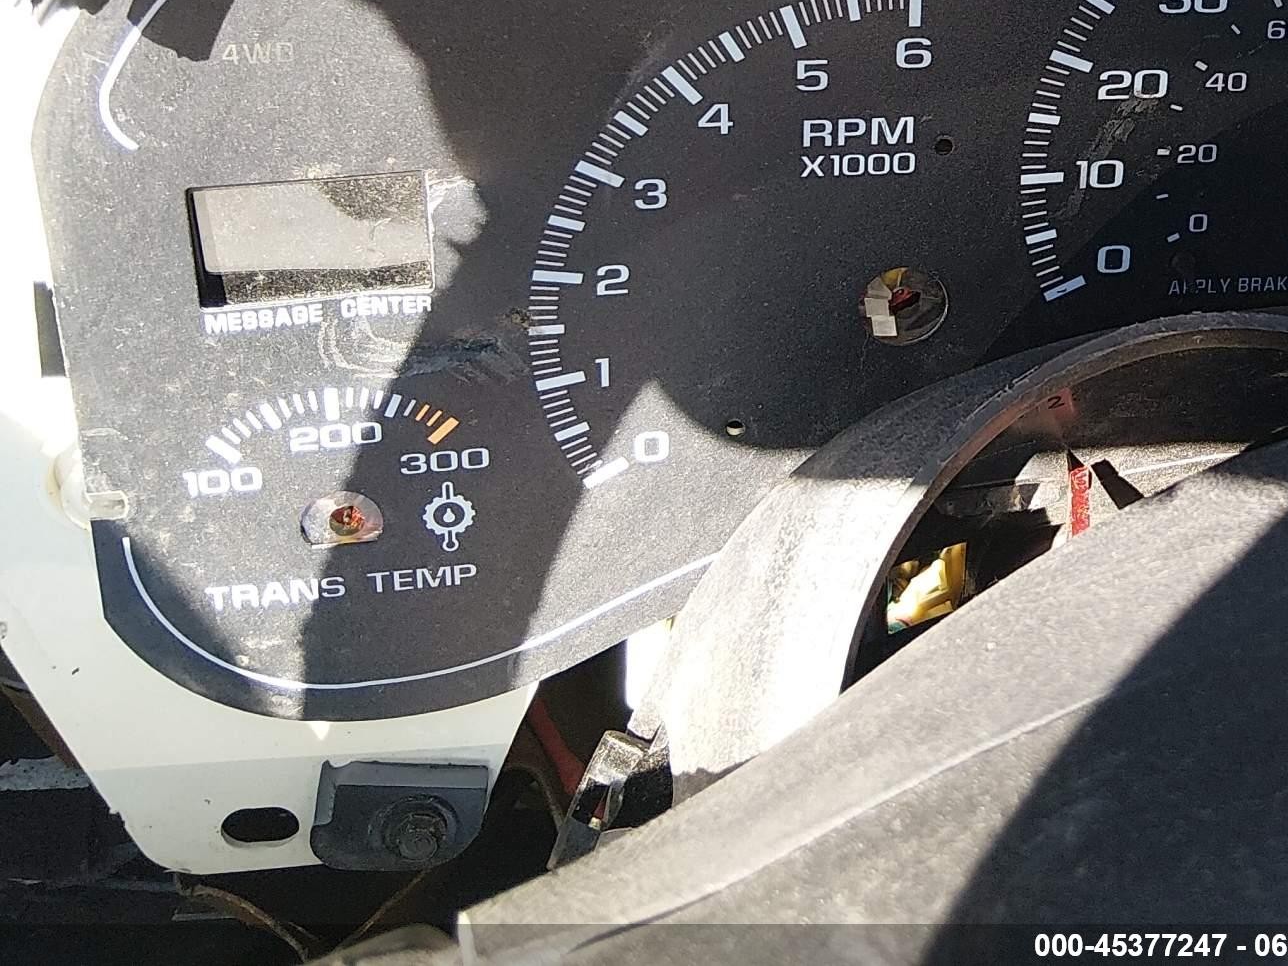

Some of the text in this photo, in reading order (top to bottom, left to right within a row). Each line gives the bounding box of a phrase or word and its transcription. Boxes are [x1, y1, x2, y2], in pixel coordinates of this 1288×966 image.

[222, 42, 295, 65] 4WD
[895, 37, 933, 69] 6
[795, 59, 829, 92] 5
[1097, 70, 1168, 100] 20
[1205, 71, 1248, 93] 40
[697, 103, 734, 135] 4
[801, 117, 916, 148] RPM
[801, 153, 916, 178] X1000
[1177, 144, 1218, 165] 20
[1075, 160, 1124, 190] 10
[634, 178, 668, 210] 3
[1188, 214, 1208, 234] 0
[1096, 244, 1131, 273] 0
[595, 265, 629, 296] 2
[1168, 279, 1231, 296] APLY
[204, 295, 432, 334] MESSAGE CENTER
[595, 358, 610, 388] 1
[289, 421, 383, 452] 200
[634, 431, 670, 463] 0
[400, 448, 490, 475] 300
[183, 466, 263, 498] 100
[206, 564, 478, 611] TRANS TEMP
